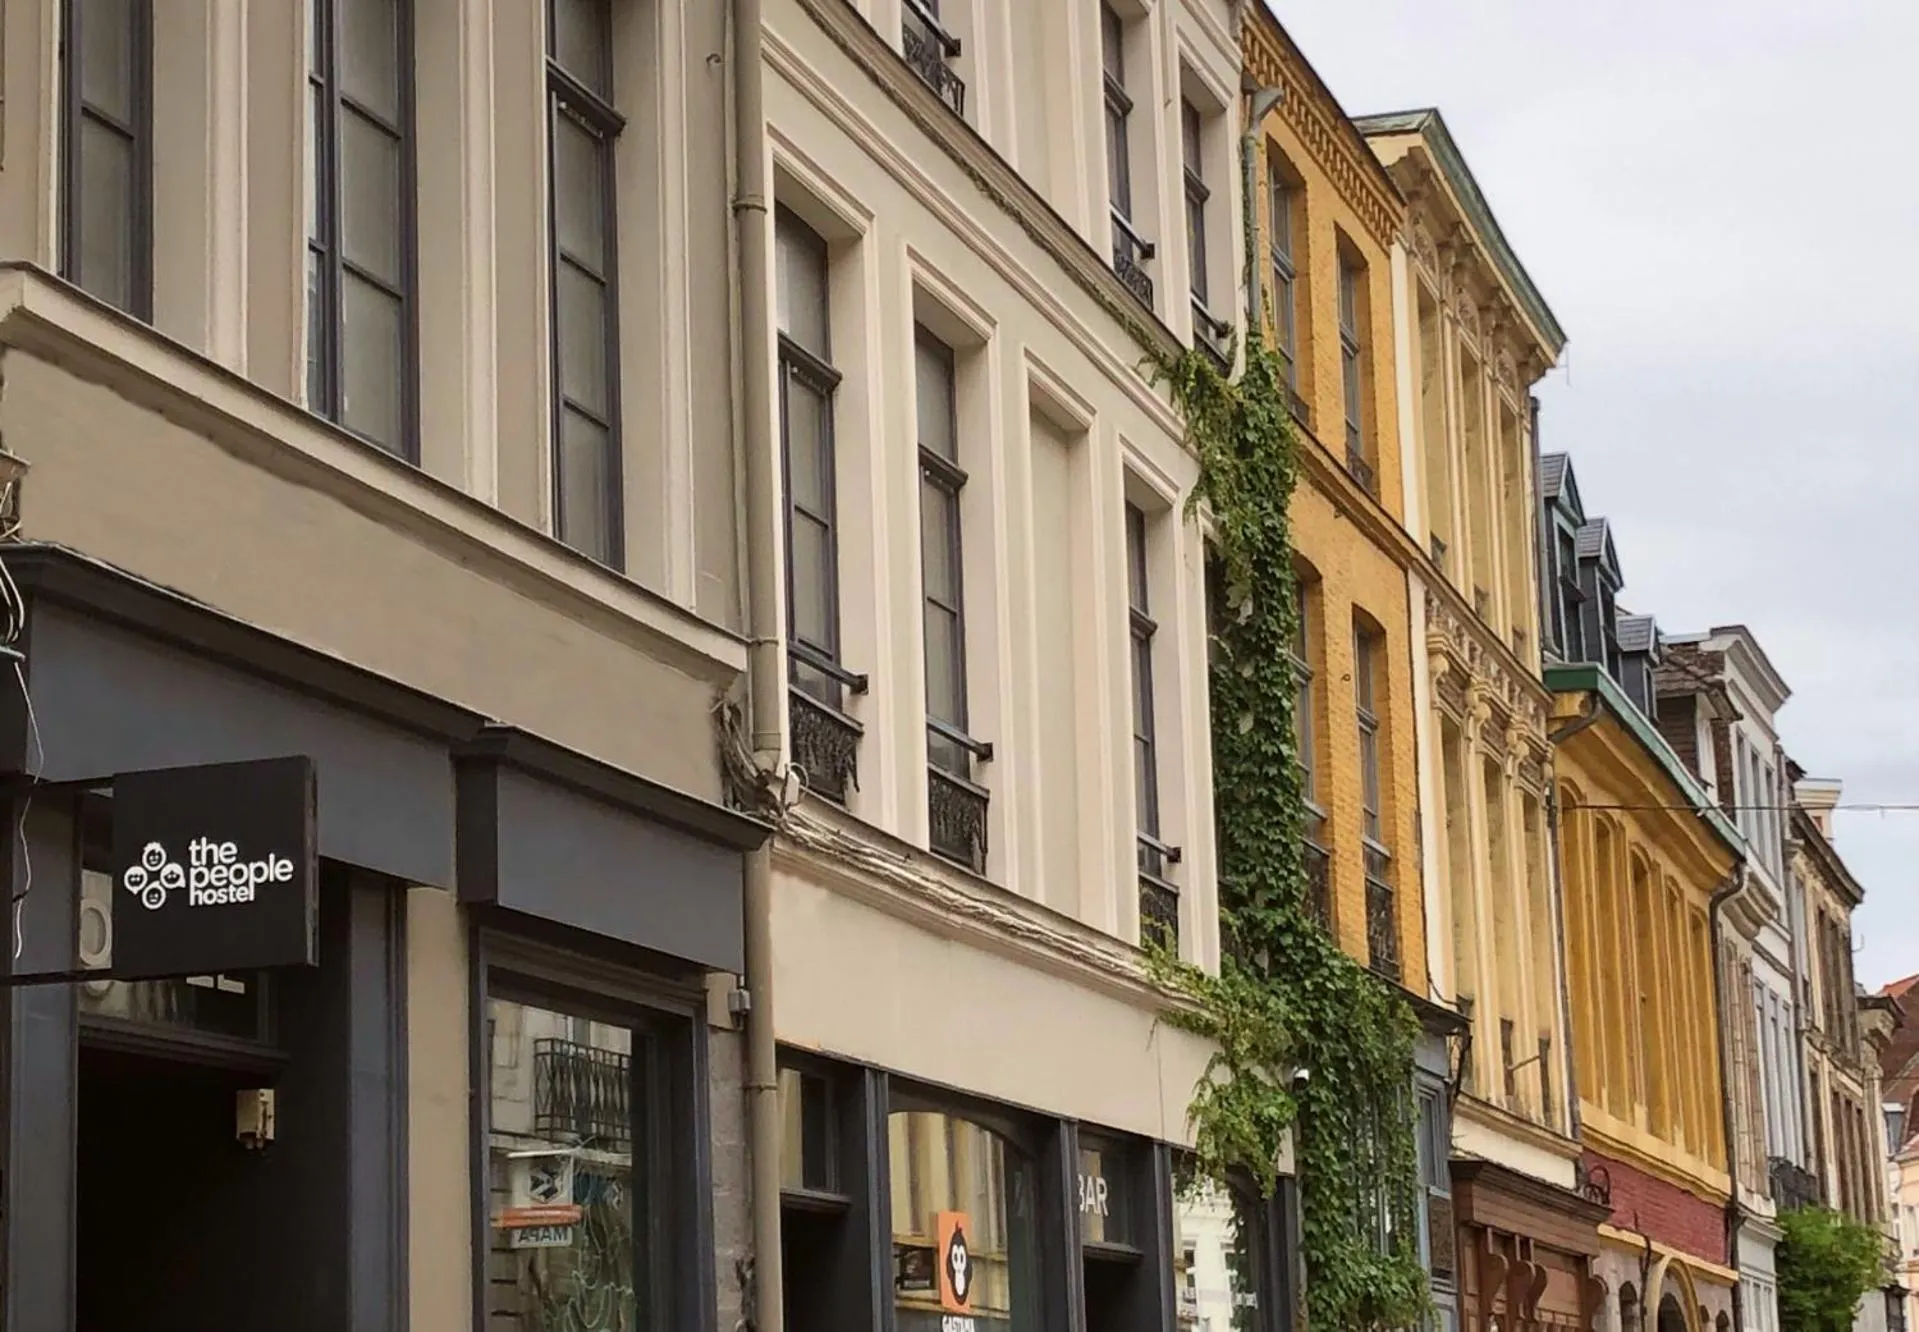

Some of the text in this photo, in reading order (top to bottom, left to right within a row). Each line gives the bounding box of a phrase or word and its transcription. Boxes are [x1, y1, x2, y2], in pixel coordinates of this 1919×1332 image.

[188, 836, 238, 866] the
[189, 852, 294, 899] people
[189, 882, 255, 907] hostel
